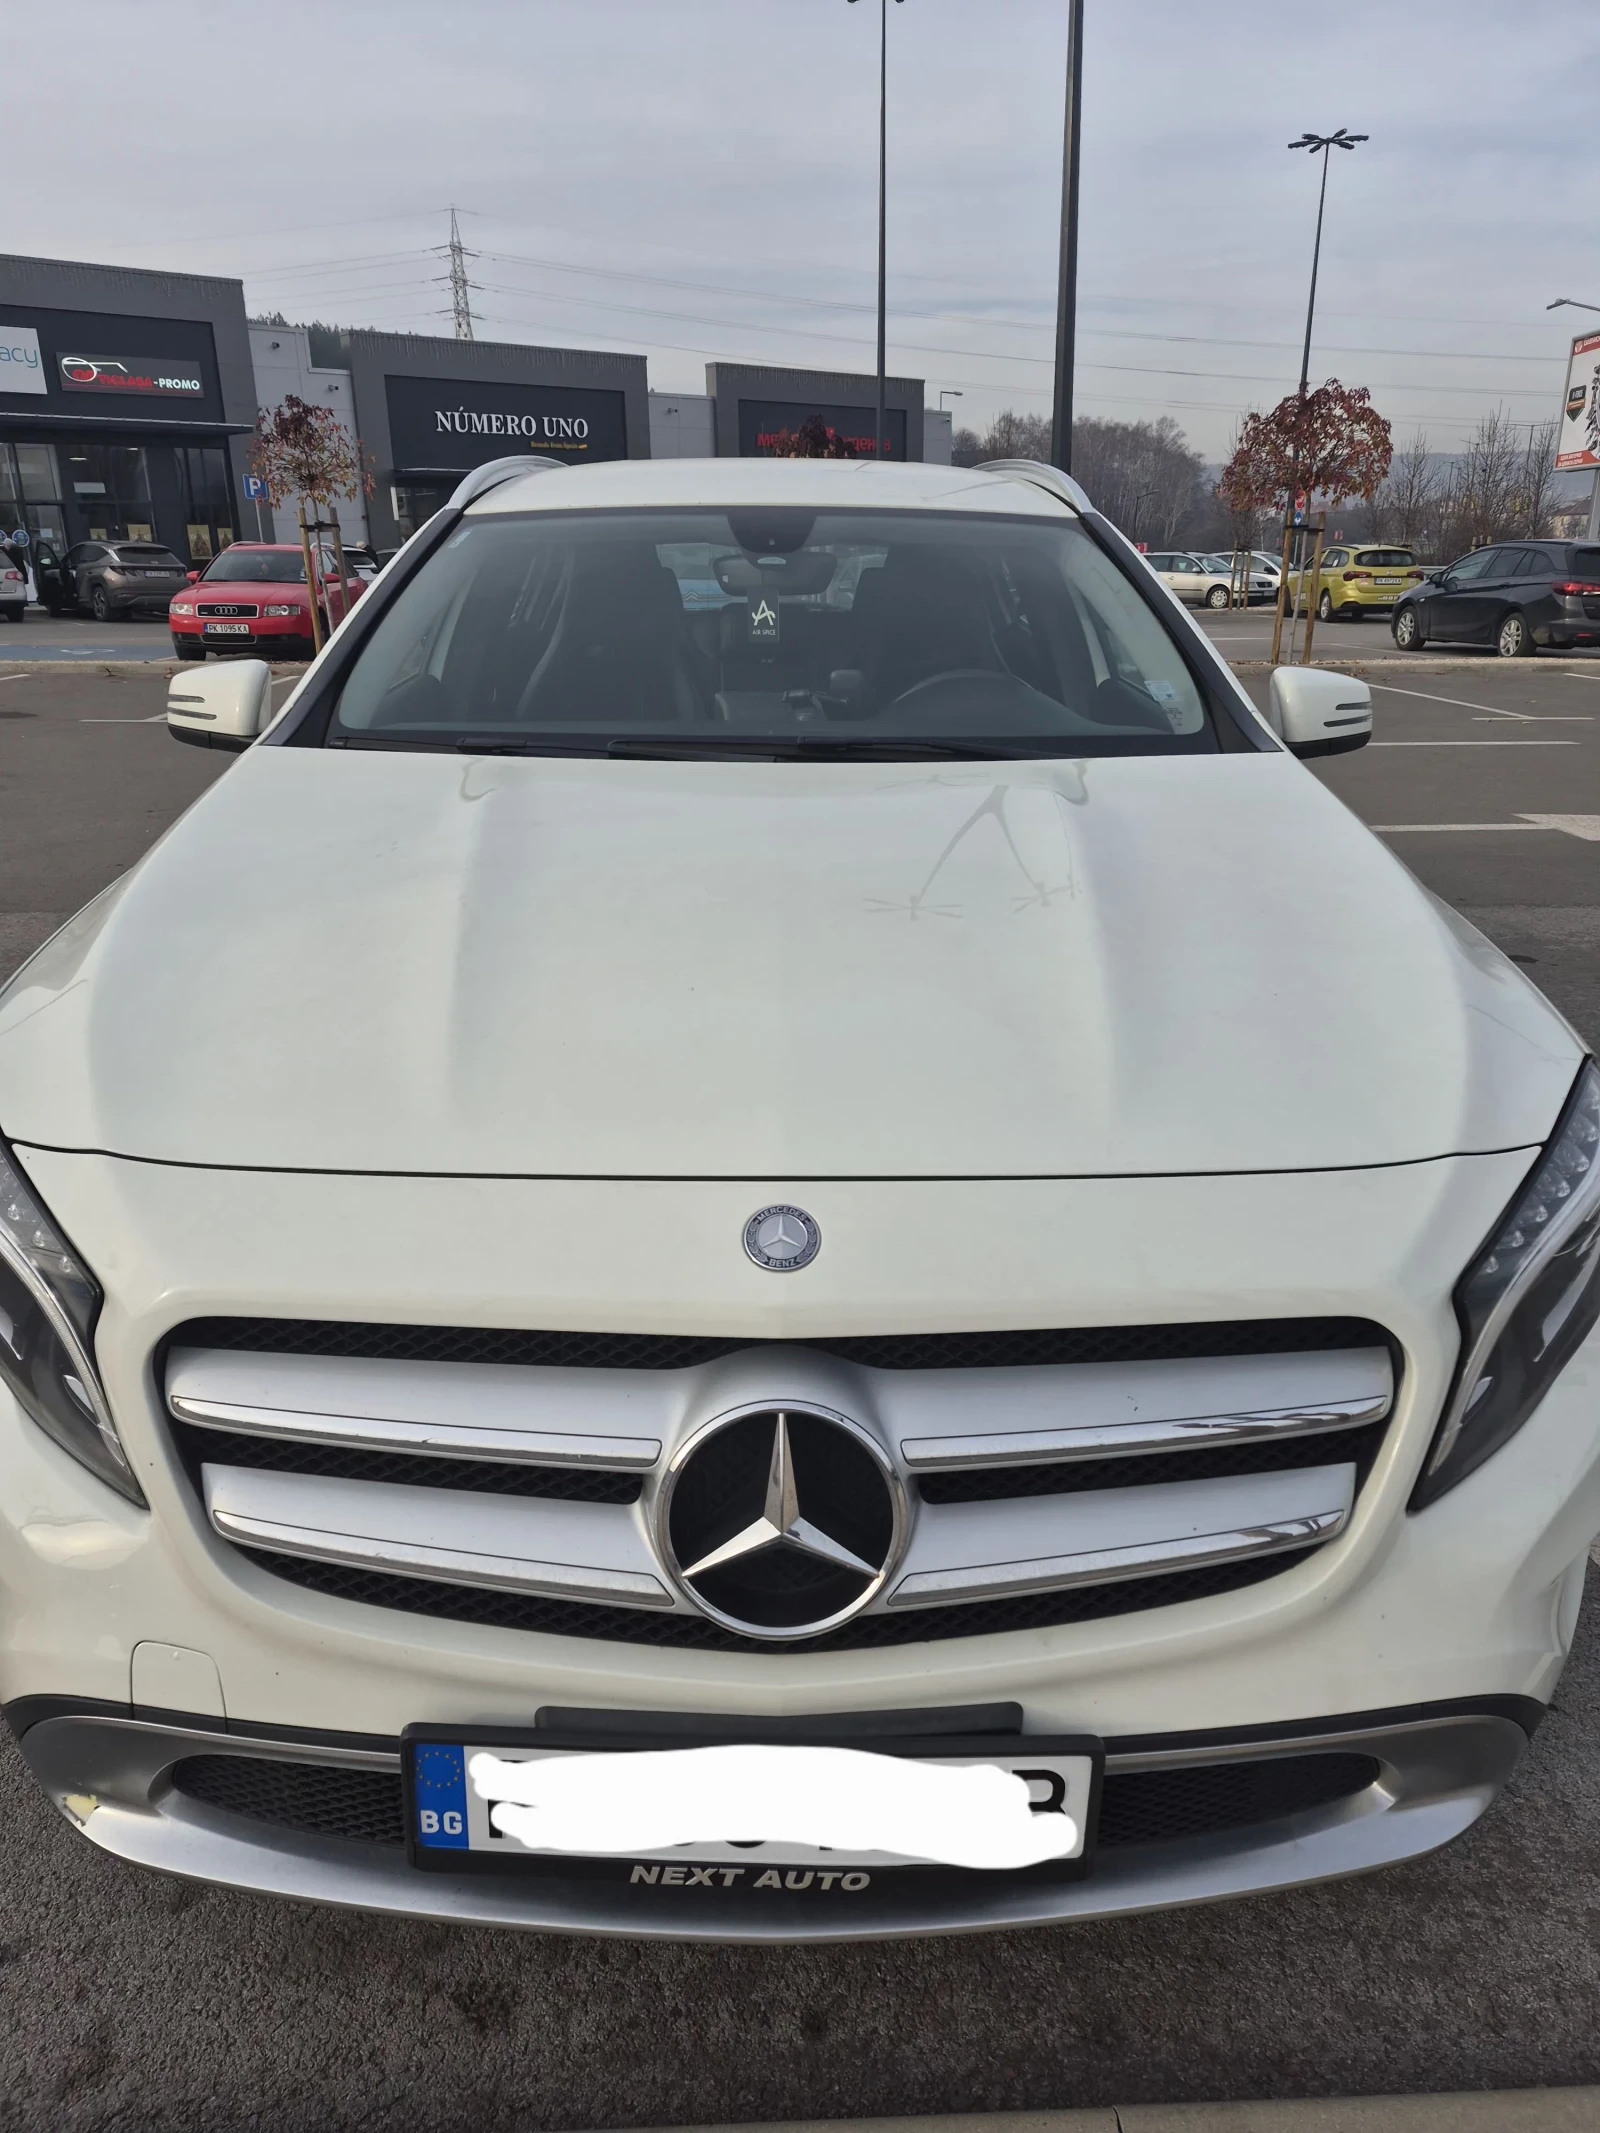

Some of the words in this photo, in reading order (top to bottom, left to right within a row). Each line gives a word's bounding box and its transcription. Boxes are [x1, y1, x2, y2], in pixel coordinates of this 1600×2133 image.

[435, 406, 537, 436] NÚMERO
[542, 416, 589, 438] UNO
[248, 477, 261, 496] P
[208, 624, 219, 633] PK
[220, 624, 237, 633] 1095
[237, 625, 248, 633] KA
[756, 1206, 807, 1222] MERCEDES
[768, 1258, 797, 1268] BENZ
[420, 1810, 463, 1835] BG
[629, 1865, 745, 1887] NEXT
[753, 1869, 871, 1891] AUTO
